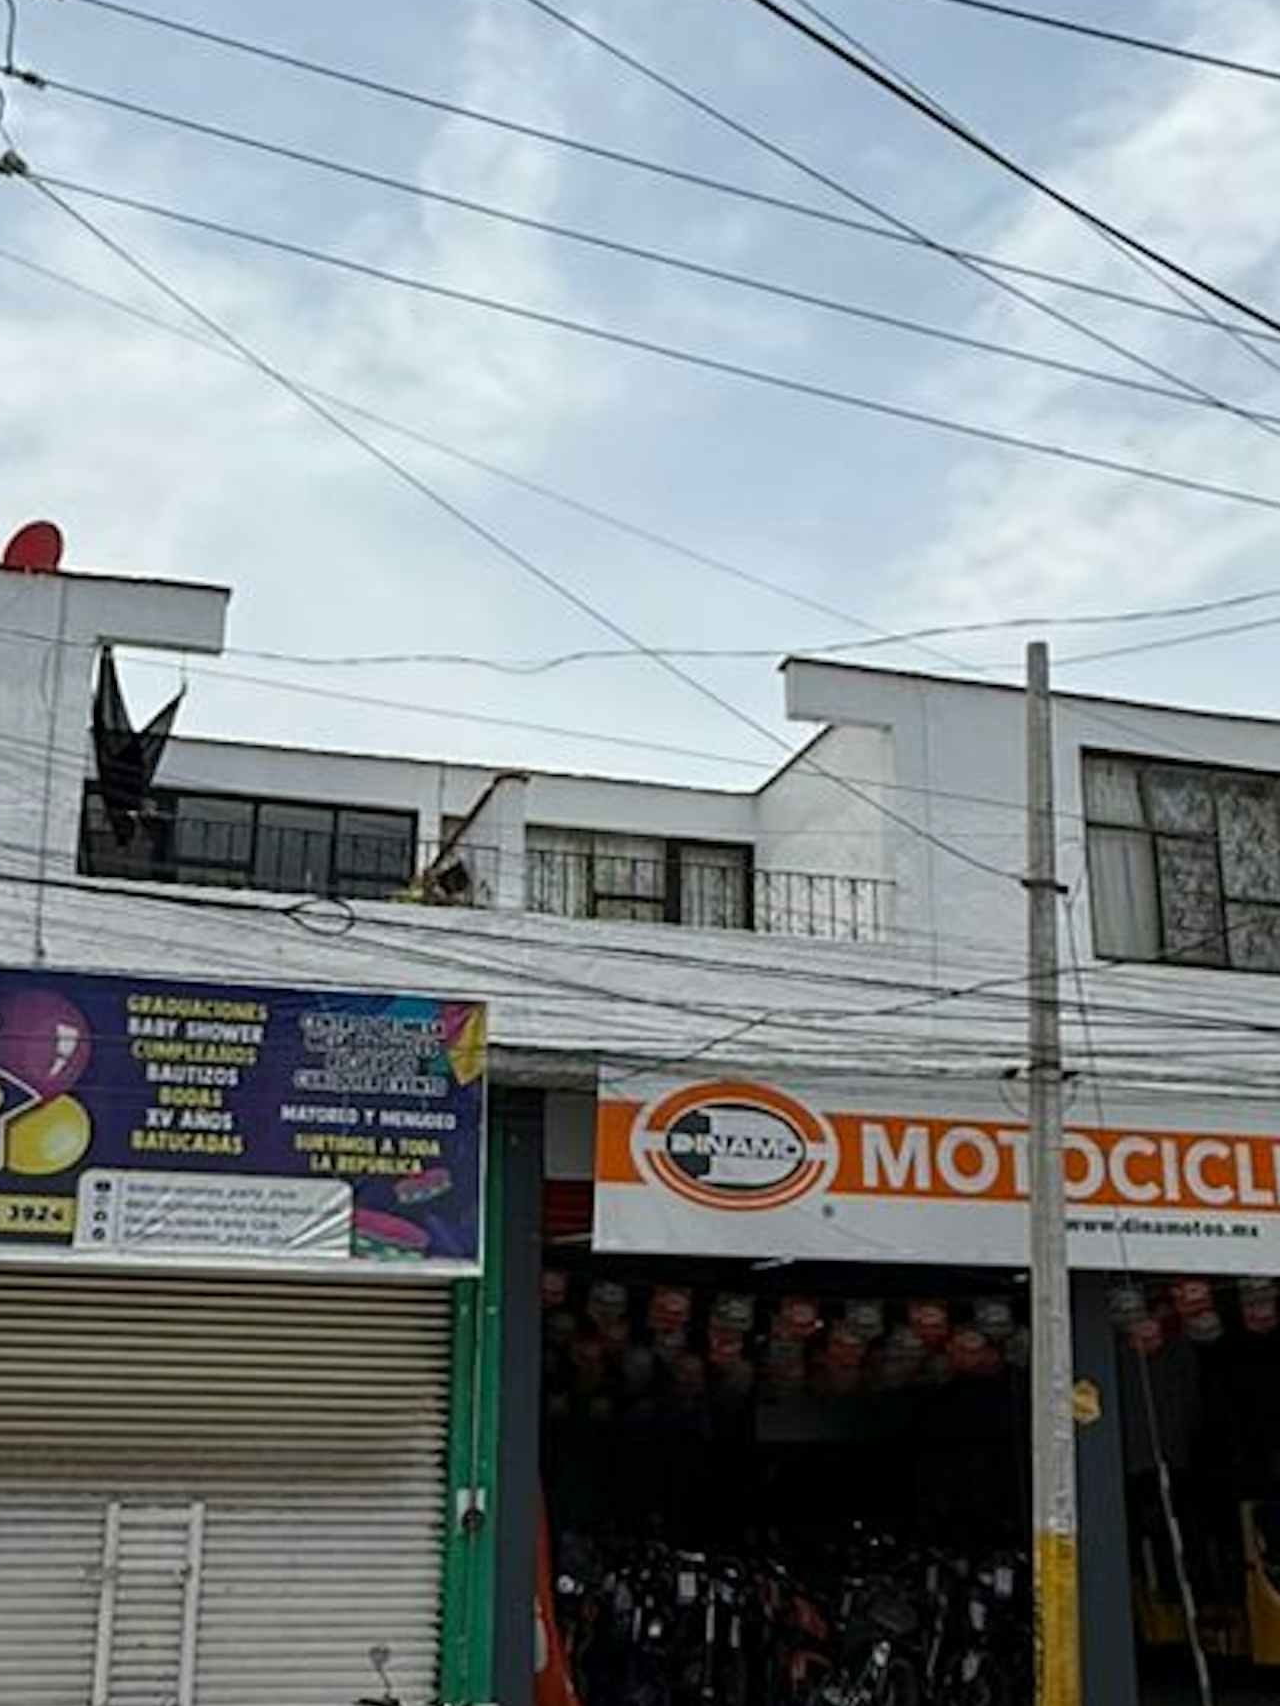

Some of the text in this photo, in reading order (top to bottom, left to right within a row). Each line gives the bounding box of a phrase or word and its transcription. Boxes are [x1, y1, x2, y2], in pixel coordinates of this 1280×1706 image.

[126, 995, 268, 1021] GRADUACIONES
[127, 1016, 264, 1044] BABY SHOWER
[146, 1062, 239, 1086] BAUTIZOS
[158, 1085, 223, 1107] BODAS
[146, 1107, 233, 1131] XV AÑOS
[280, 1105, 360, 1125] MAYOREO
[364, 1109, 375, 1126] Y
[131, 1130, 244, 1157] BATUCADAS
[295, 1133, 441, 1156] SURTIMOS A TODA
[670, 1133, 803, 1161] DINAMO
[310, 1153, 334, 1171] LA
[8, 1204, 64, 1223] 3924
